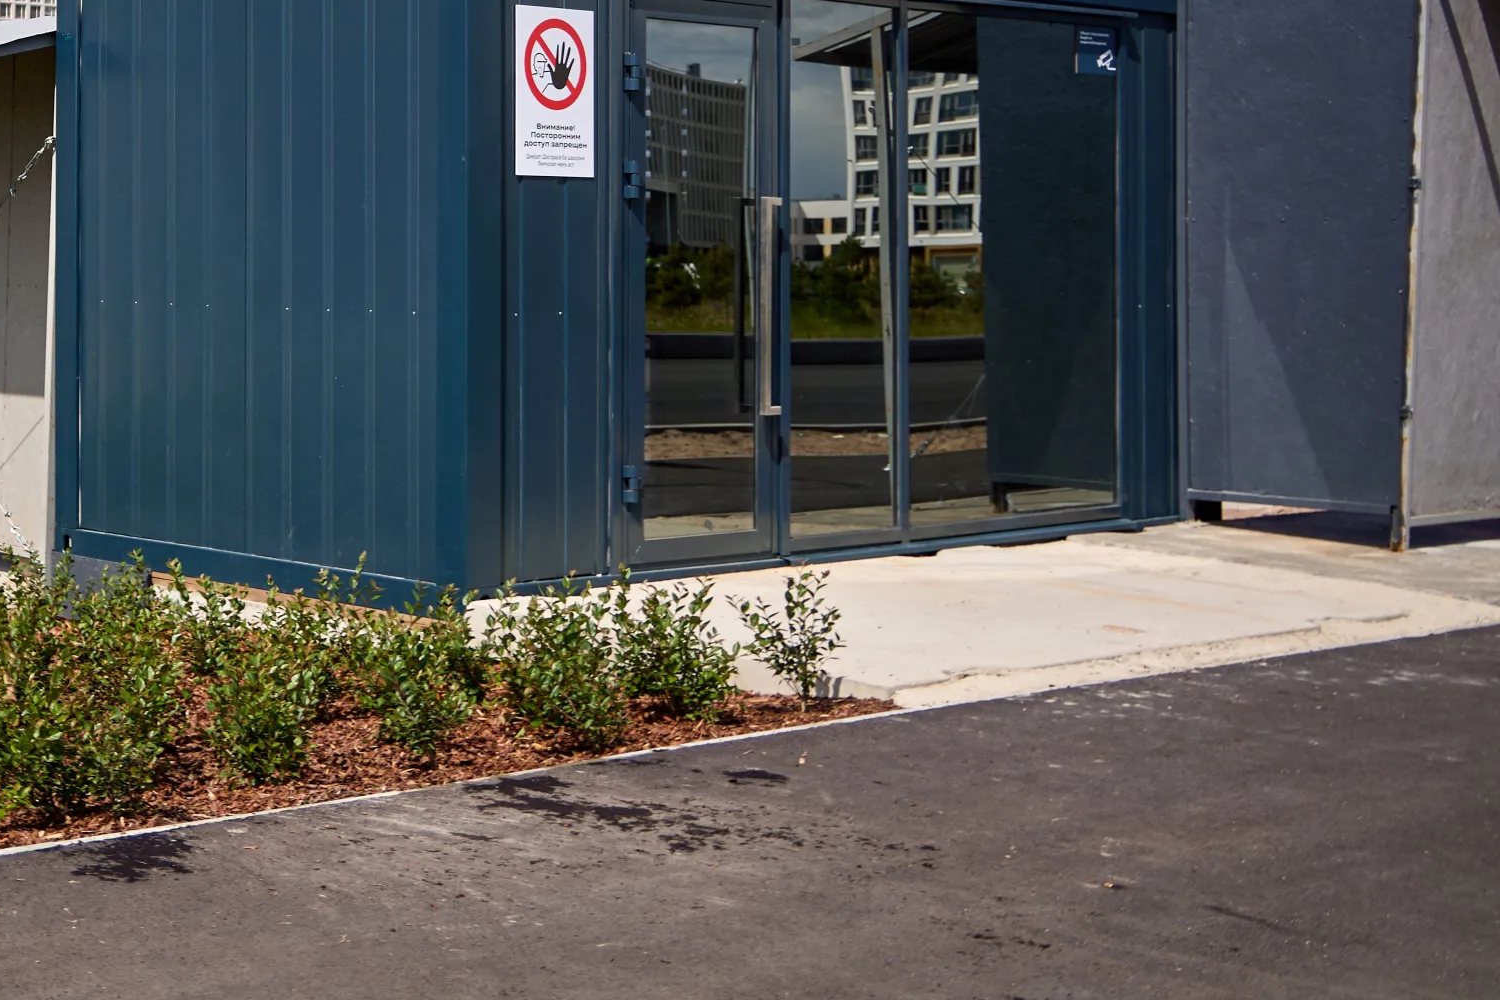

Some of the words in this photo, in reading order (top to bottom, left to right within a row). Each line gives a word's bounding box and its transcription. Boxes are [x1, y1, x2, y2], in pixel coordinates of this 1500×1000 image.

[536, 122, 576, 132] Внимание!
[530, 131, 581, 141] Посторонним
[523, 140, 550, 149] доступ
[550, 141, 588, 150] запрещен
